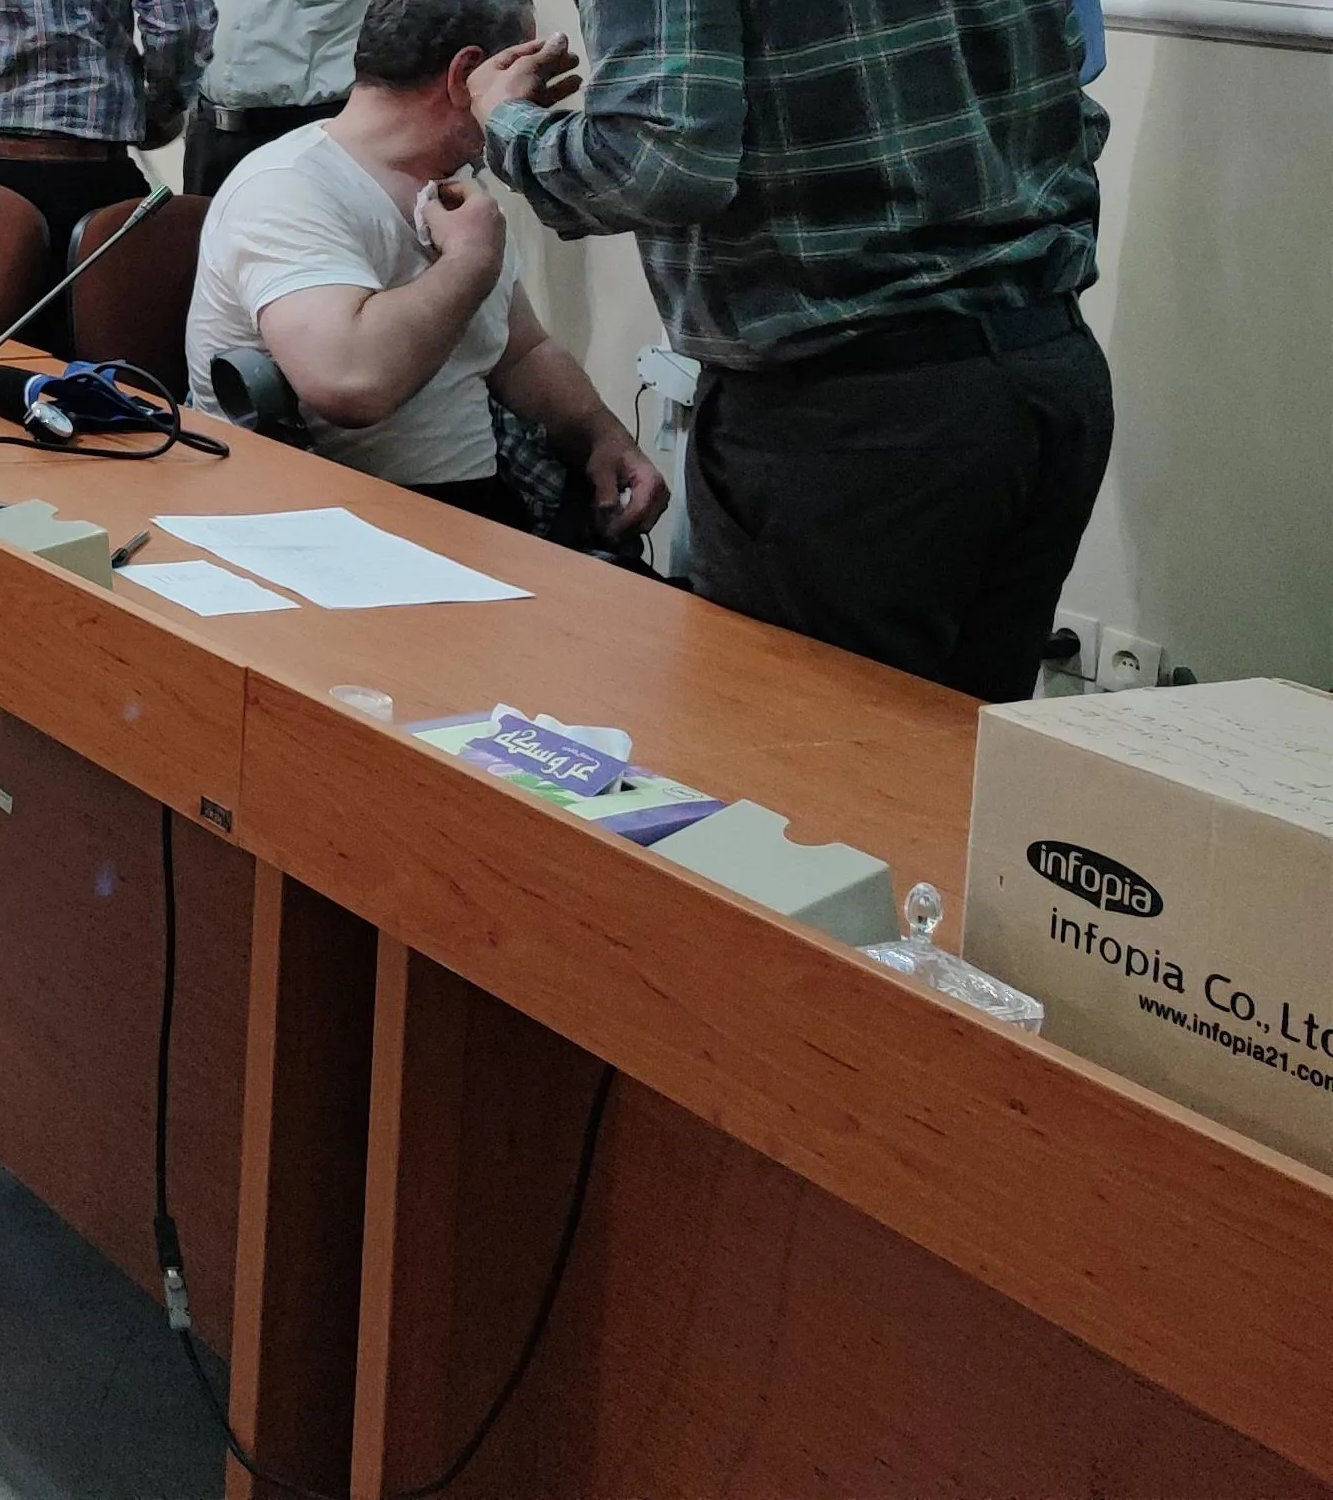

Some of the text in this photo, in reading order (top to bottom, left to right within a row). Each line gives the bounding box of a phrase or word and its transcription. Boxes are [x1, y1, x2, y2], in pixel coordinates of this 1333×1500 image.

[1038, 843, 1153, 914] infopia
[1050, 907, 1186, 994] infopia
[1204, 973, 1270, 1033] Co.,
